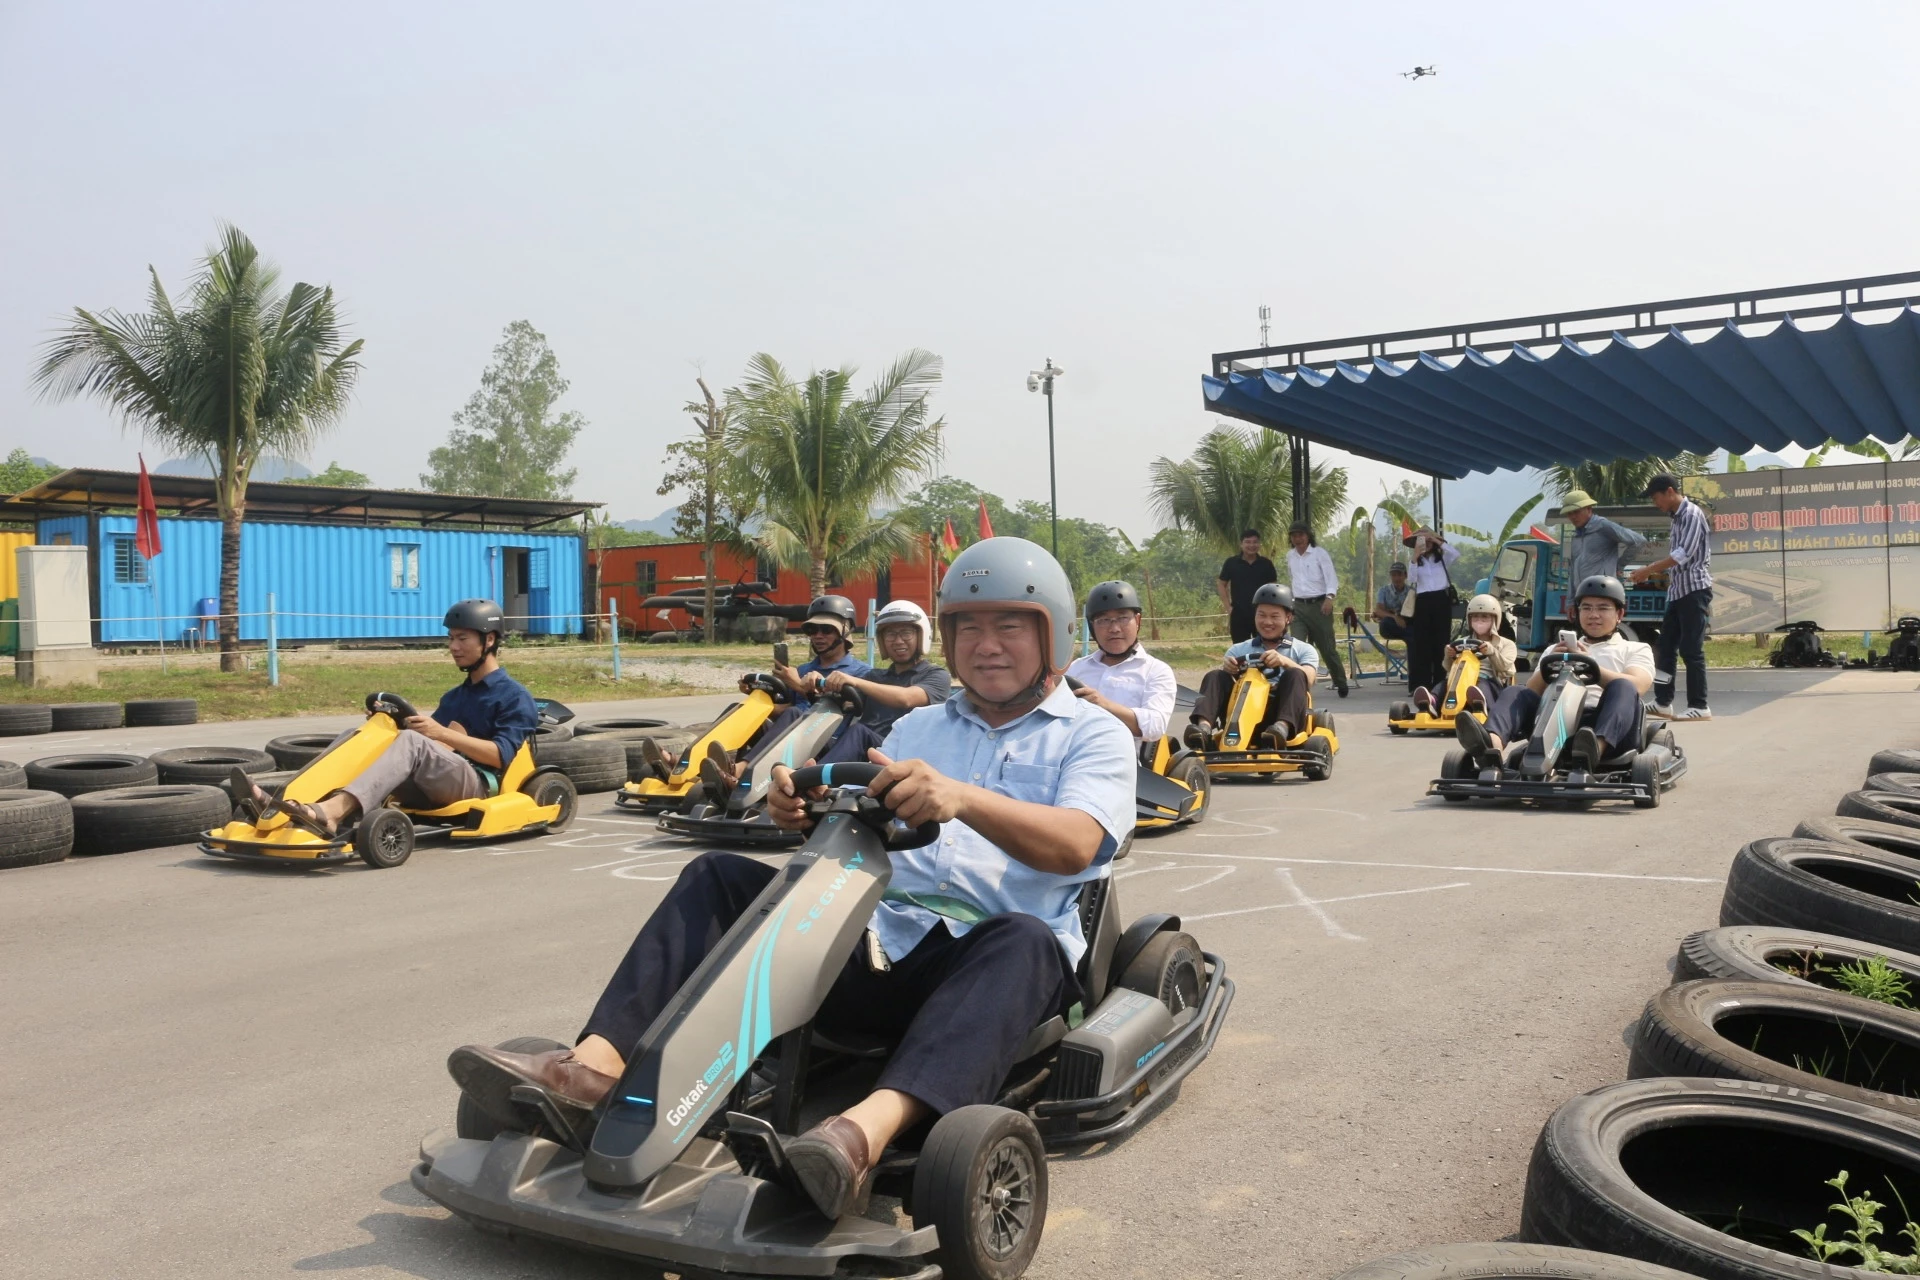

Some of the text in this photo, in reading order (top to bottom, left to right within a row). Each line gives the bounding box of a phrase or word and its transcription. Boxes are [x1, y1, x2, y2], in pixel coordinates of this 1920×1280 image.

[796, 851, 864, 934] SEGWAY
[666, 1079, 708, 1127] Gokart
[1458, 1266, 1504, 1277] RADIAL
[1507, 1265, 1573, 1276] TUBELESS
